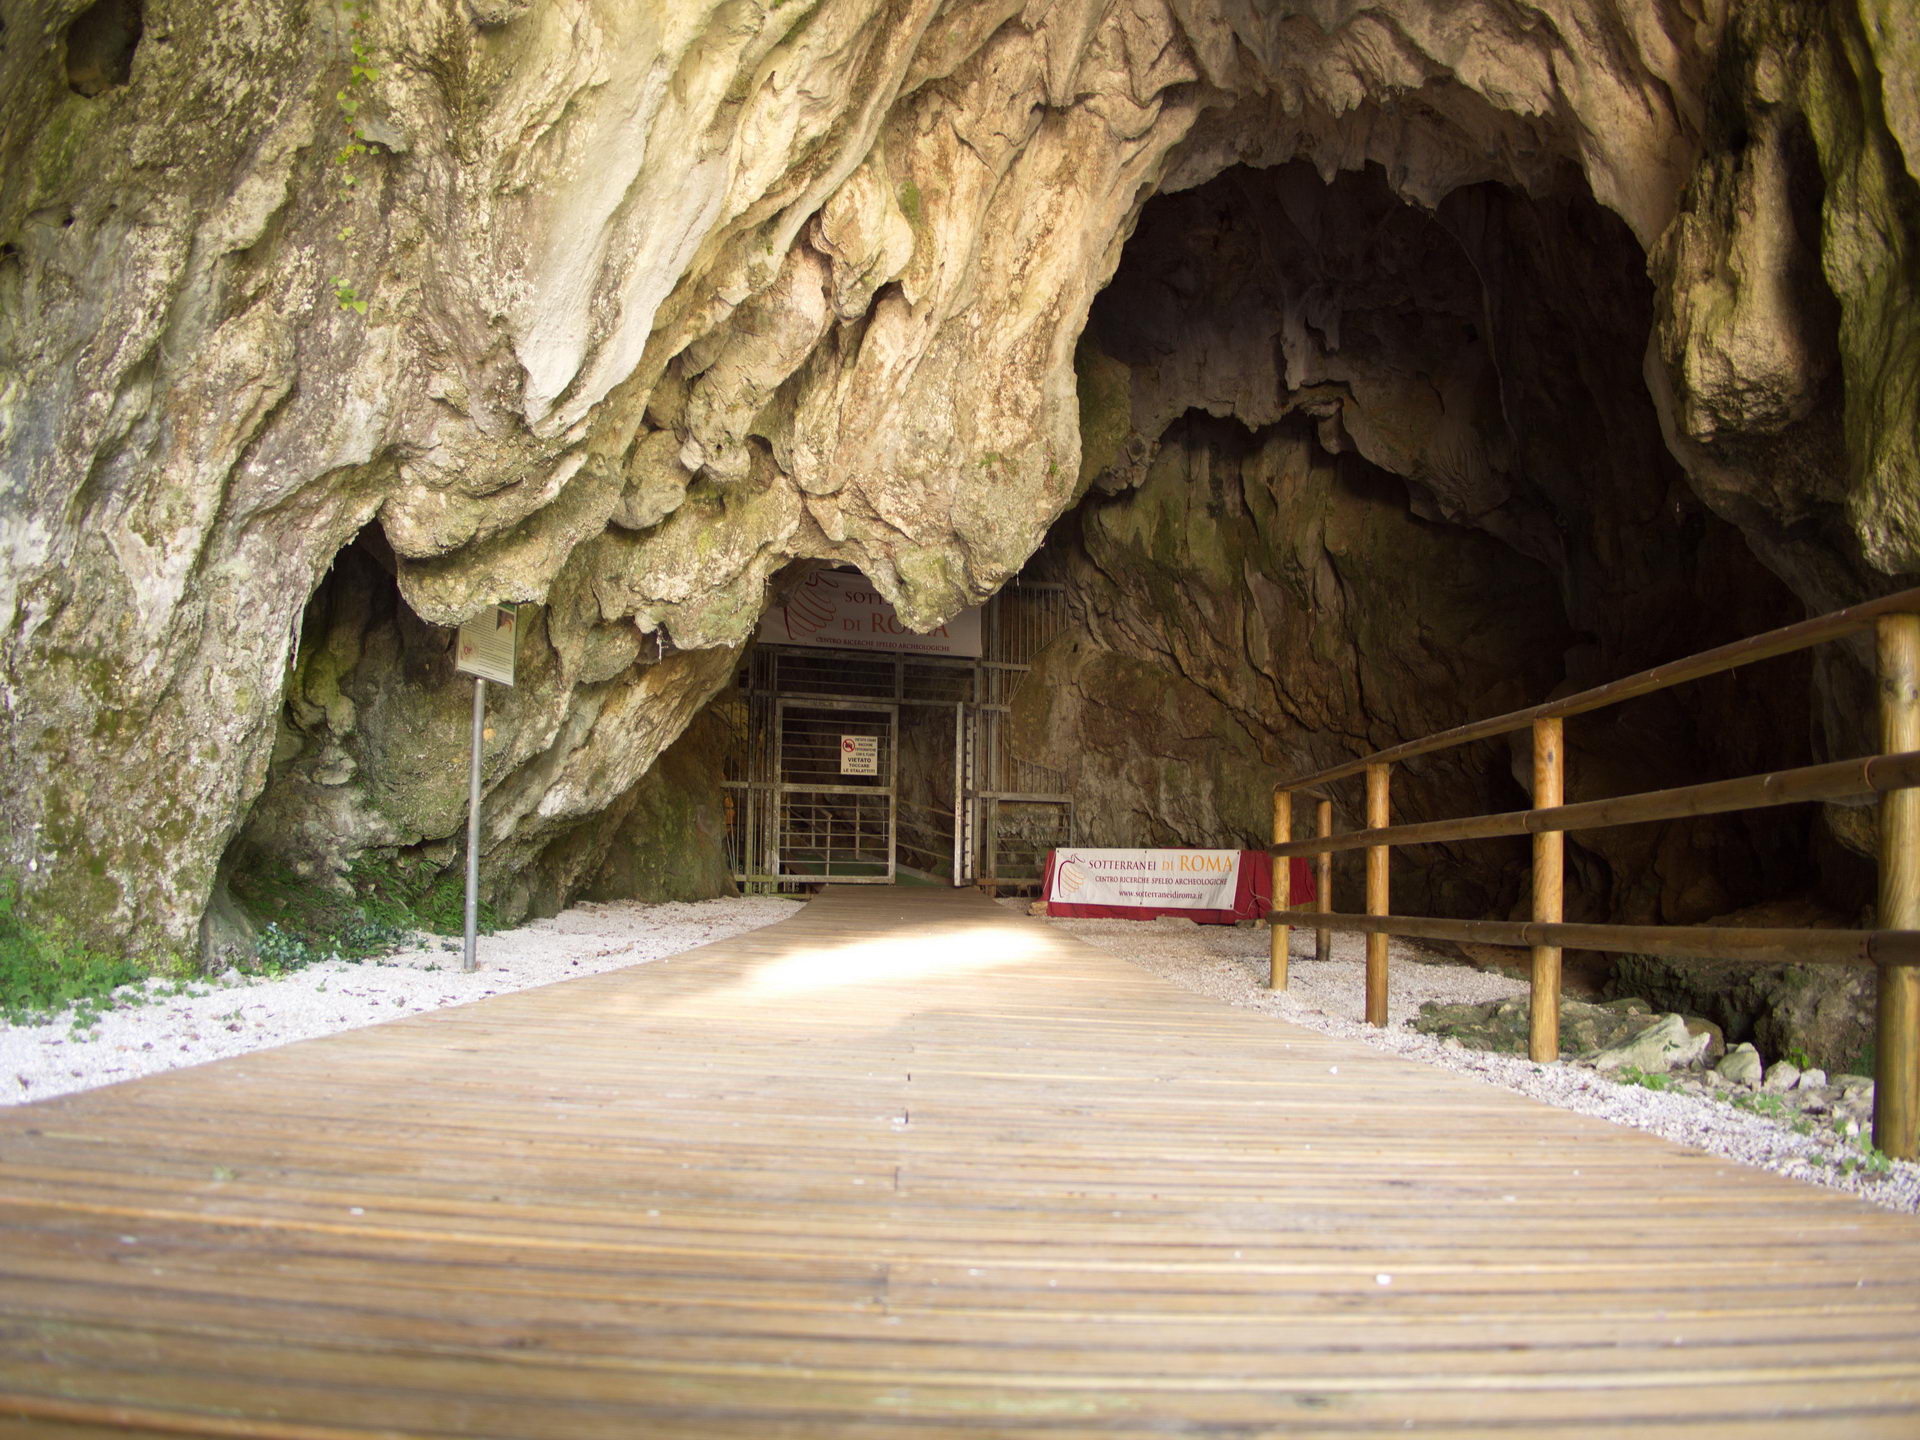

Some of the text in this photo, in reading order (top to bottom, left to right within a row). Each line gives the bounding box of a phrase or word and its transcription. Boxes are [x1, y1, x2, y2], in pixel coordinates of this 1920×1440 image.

[843, 612, 949, 638] DI ROA
[815, 636, 950, 651] CENTRO RICERCHE SPELEO ARCHEOLOGICHE
[1088, 859, 1157, 871] SOTTERRANEI
[1180, 855, 1233, 873] ROMA
[1095, 875, 1228, 886] CENTRO RICERCHE SPELEO ARCHEOLOGICHE
[1119, 889, 1203, 900] www.sotterraneidiroma.it
